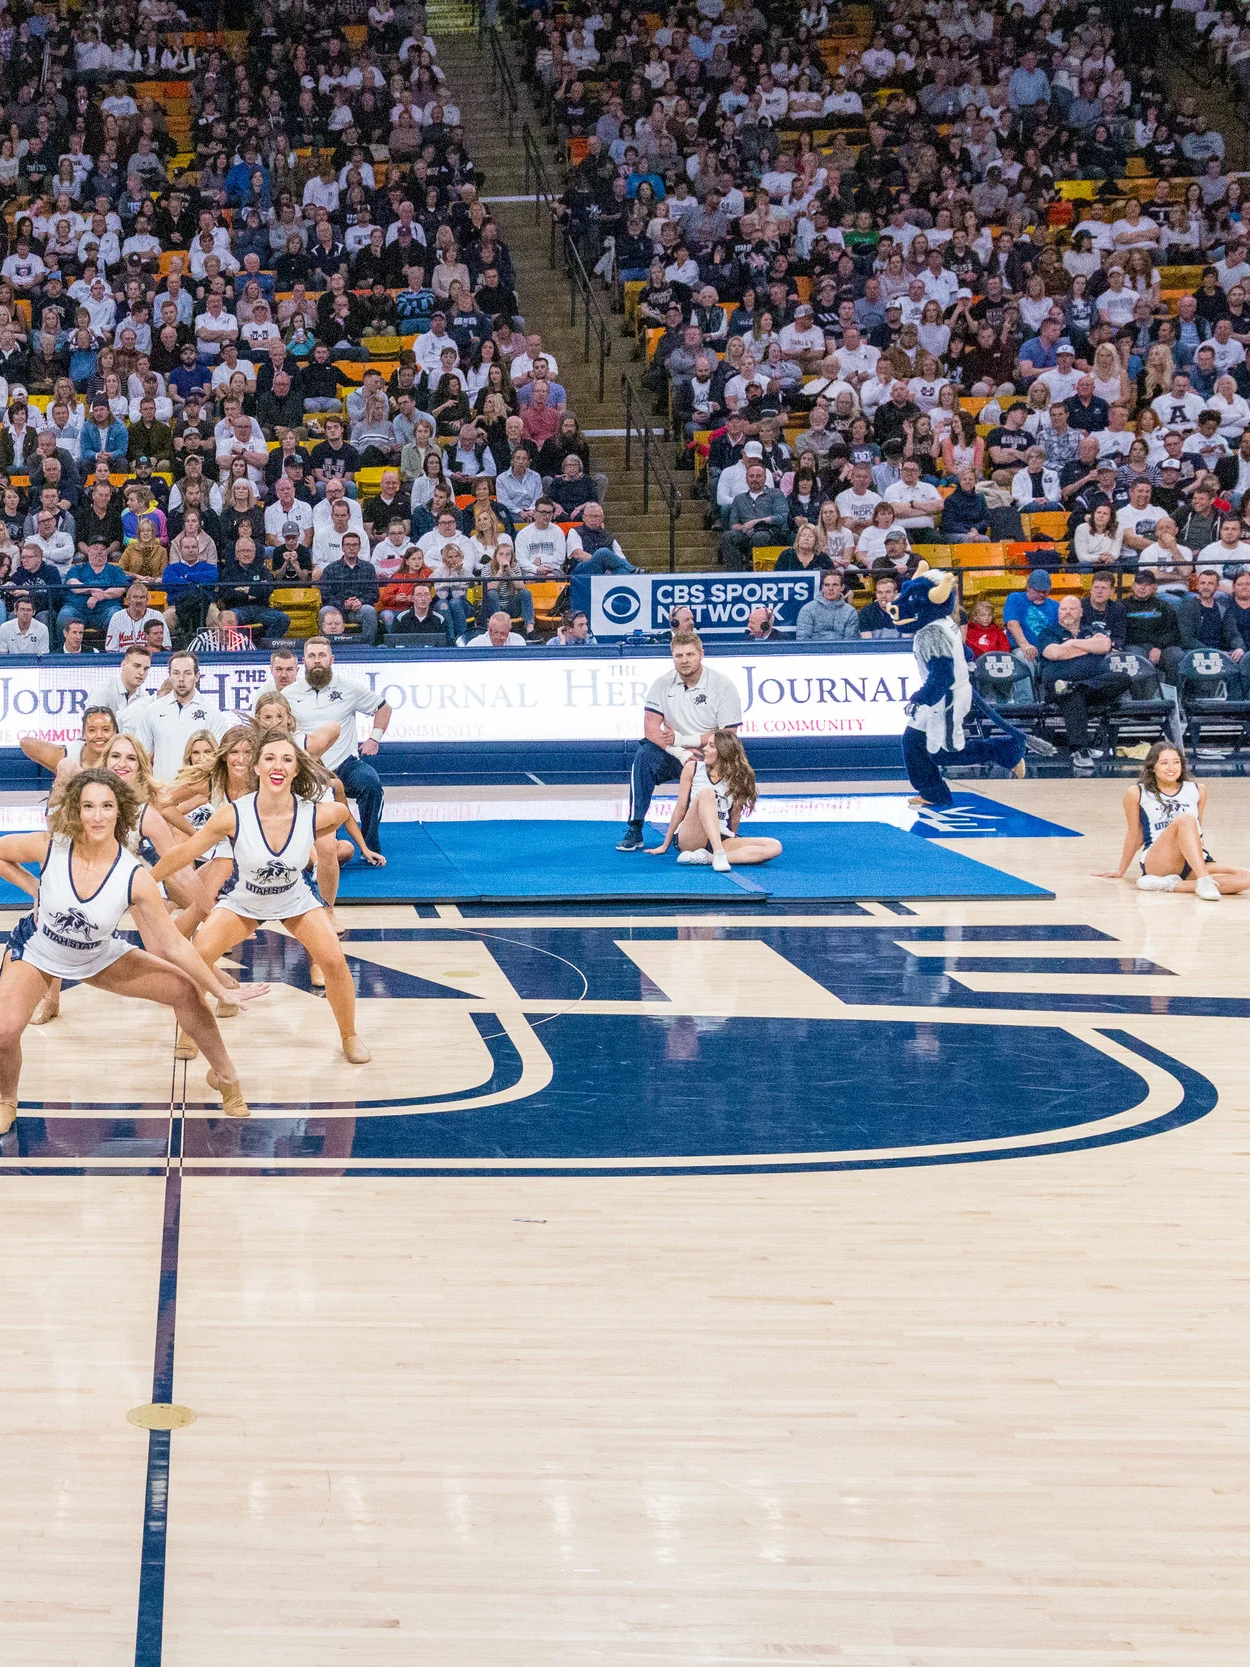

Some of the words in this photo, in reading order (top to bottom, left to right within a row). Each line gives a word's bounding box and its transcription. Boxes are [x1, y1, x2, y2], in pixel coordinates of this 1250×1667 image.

[657, 584, 706, 603] CBS
[710, 582, 809, 602] SPORTS
[235, 670, 266, 682] THE
[563, 669, 648, 707] HER
[764, 718, 866, 732] COMMUNITY
[1154, 821, 1170, 831] UTA
[245, 881, 272, 895] UTAH
[42, 926, 68, 946] UTAH
